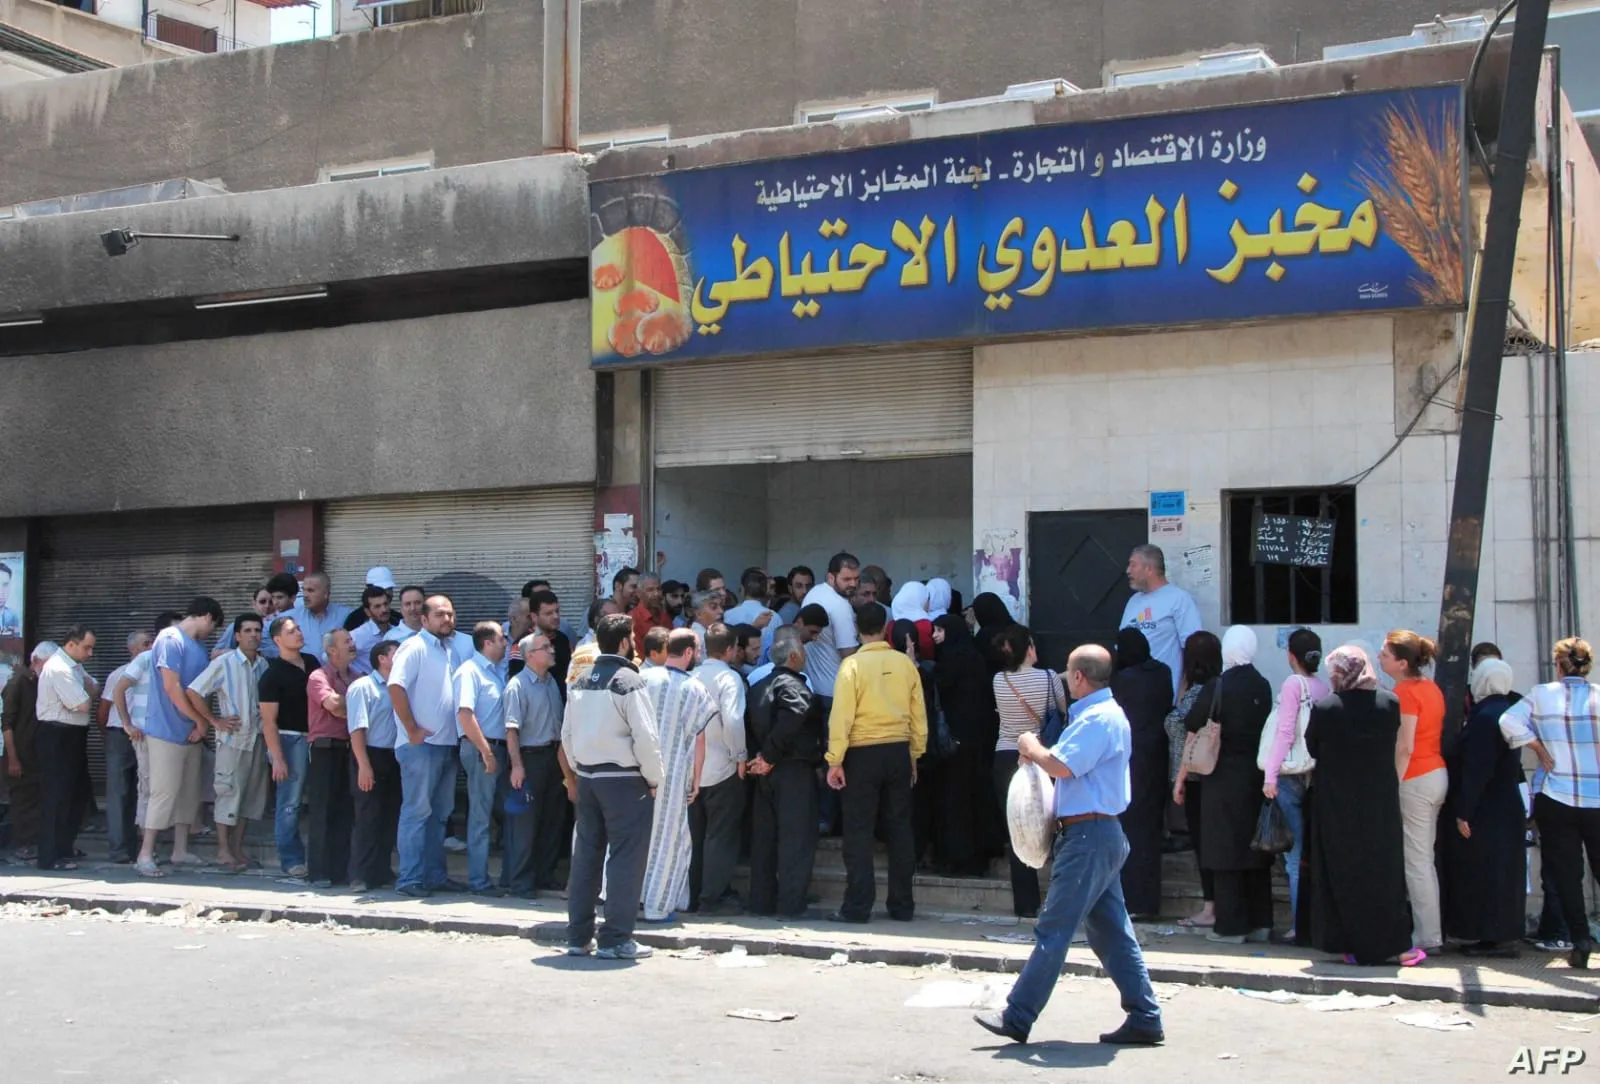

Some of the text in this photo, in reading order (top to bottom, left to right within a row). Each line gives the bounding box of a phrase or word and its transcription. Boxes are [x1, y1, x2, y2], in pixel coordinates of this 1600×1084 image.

[1111, 133, 1204, 168] الاقتصاد
[1211, 128, 1267, 163] وزارة
[857, 164, 938, 202] المخابز
[943, 157, 992, 190] لجنة
[1012, 146, 1085, 183] التجارة
[754, 173, 853, 212] الاحتياطية
[690, 171, 1378, 335] مخبز العدوي الاحتياطي
